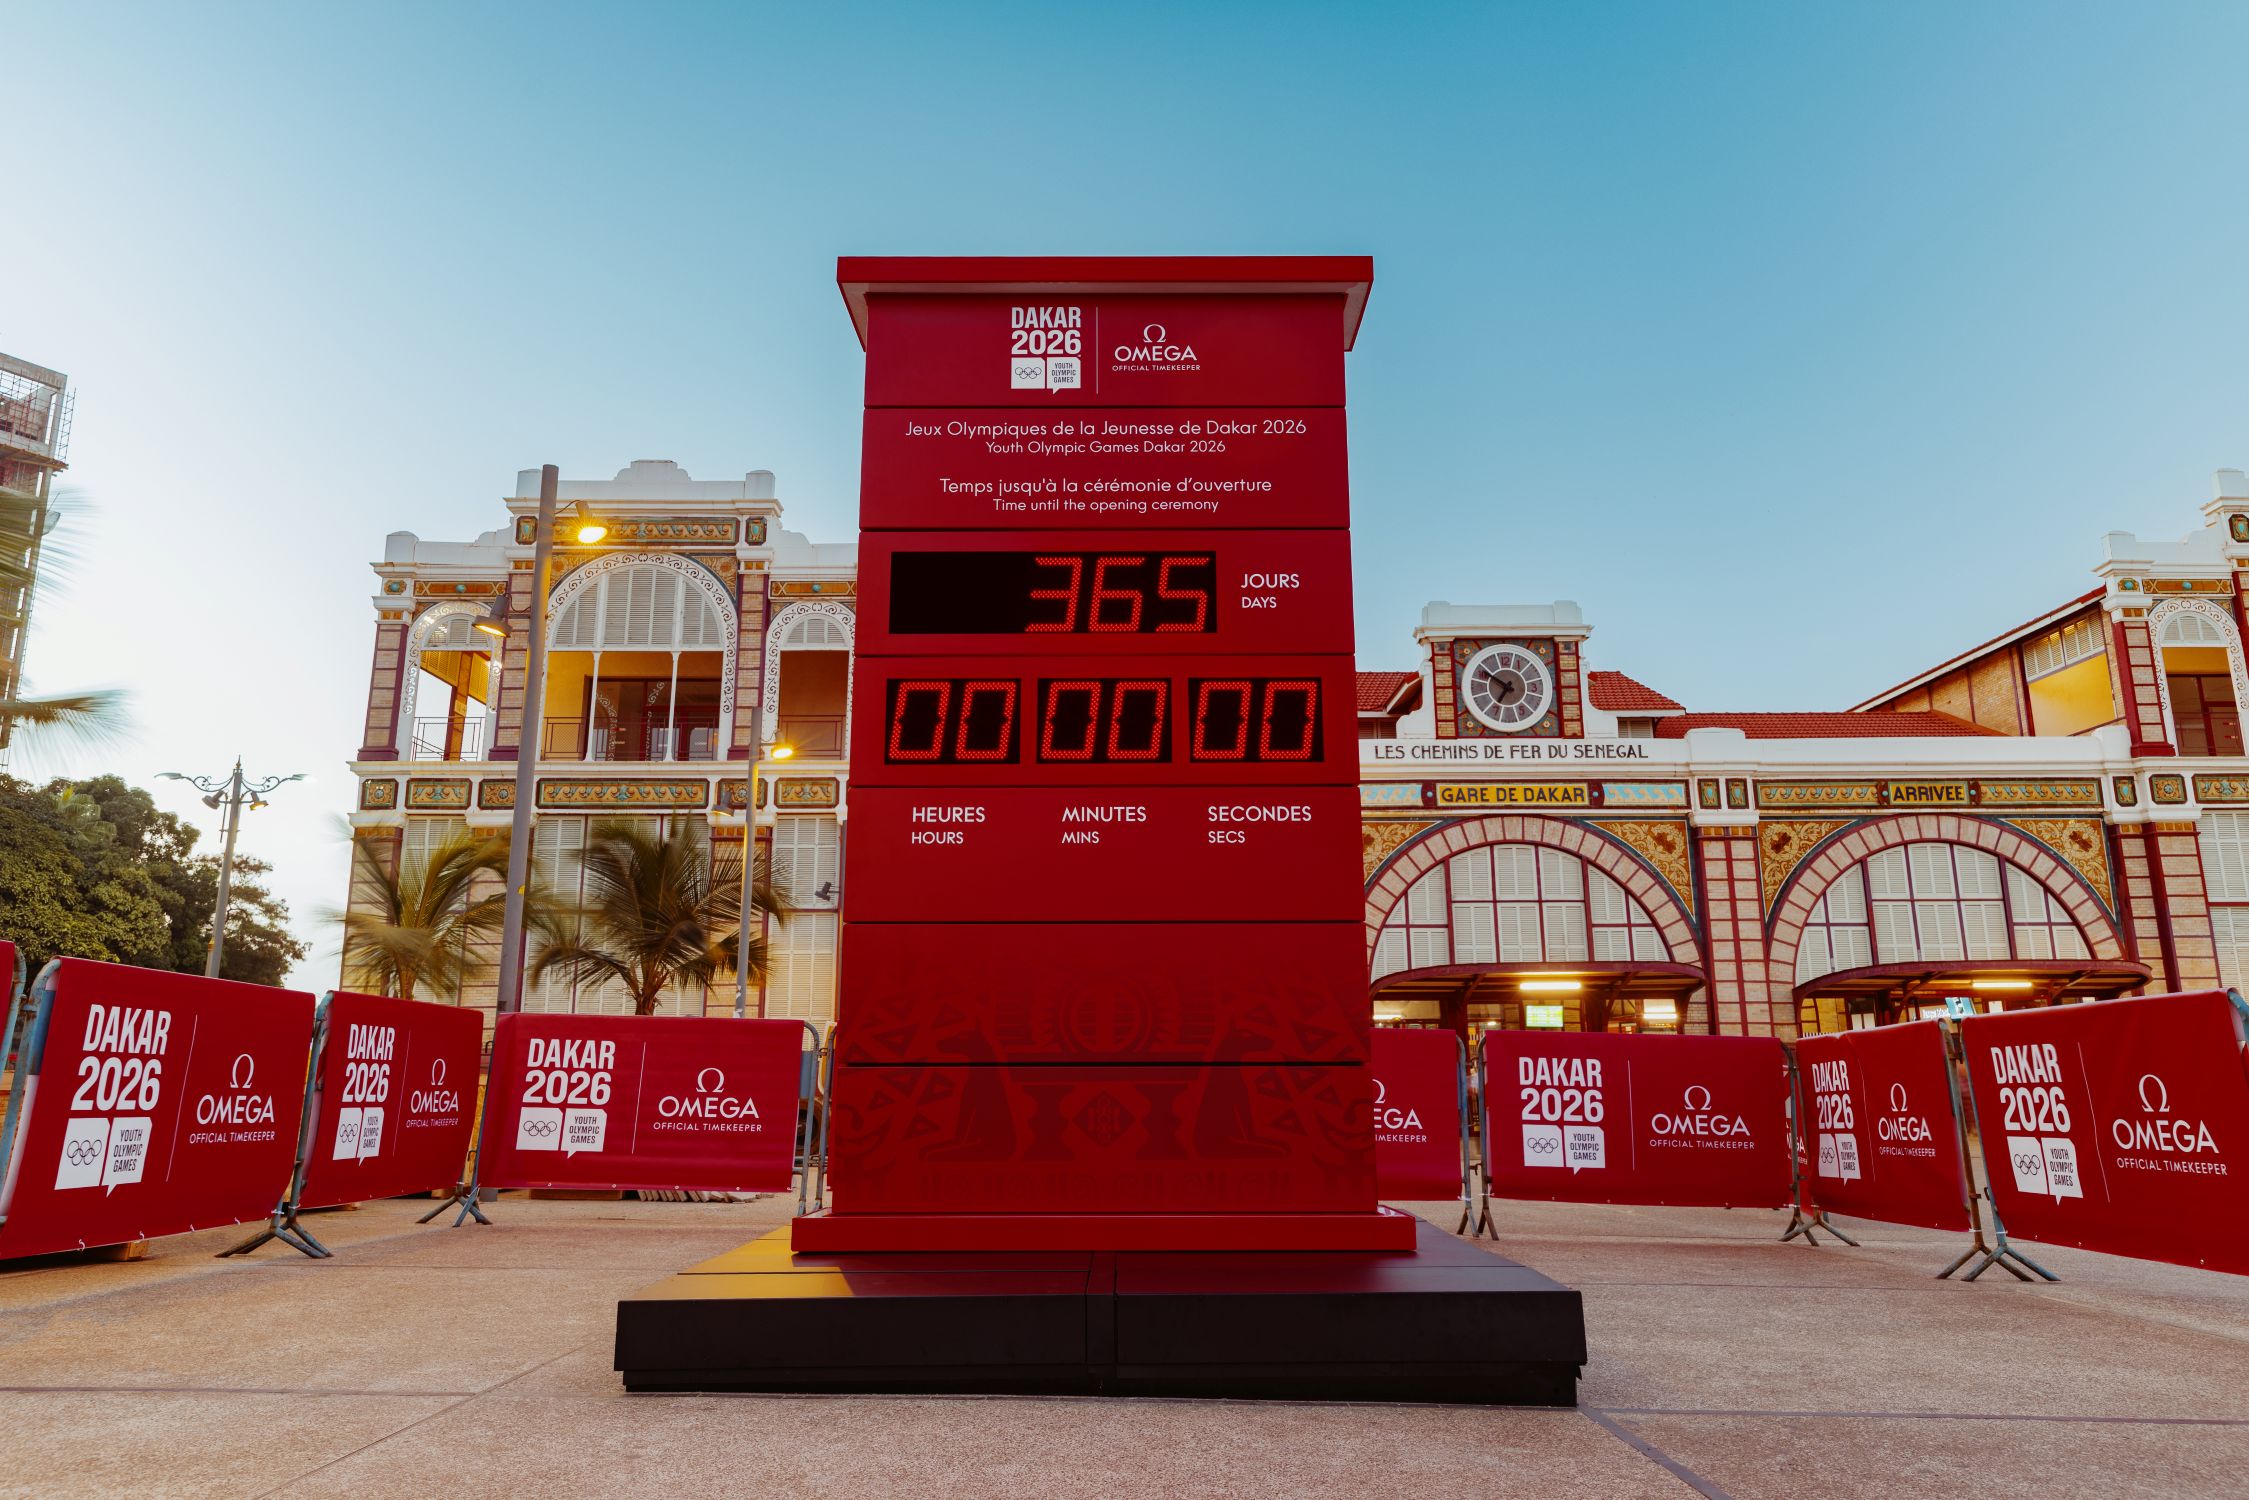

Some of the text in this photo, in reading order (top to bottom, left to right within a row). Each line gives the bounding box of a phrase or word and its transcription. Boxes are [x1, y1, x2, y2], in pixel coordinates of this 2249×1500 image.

[1011, 307, 1081, 328] DAKAR
[1011, 329, 1081, 355] 2026
[1114, 345, 1197, 362] OMEGA
[905, 419, 1306, 439] Jeux Olympiques de la Jeunesse de Dakar 2026
[986, 440, 1226, 456] Youth Olympic Games Dakar 2026
[940, 478, 993, 496] Temps
[1063, 478, 1078, 492] la
[1084, 478, 1171, 492] cérémonie
[993, 498, 1219, 514] Time until the opening ceremony
[1241, 573, 1299, 588] JOURS
[1025, 557, 1210, 632] 365
[1242, 596, 1277, 608] DAYS
[889, 681, 1017, 759] 00
[1040, 681, 1168, 759] 00
[1192, 681, 1318, 759] 00
[1375, 745, 1648, 759] LES CHEMINS DE FER DU SENEGAL
[1441, 787, 1584, 802] GARE DE DAKAR
[1893, 786, 1964, 801] ARRIVEE
[913, 807, 985, 822] HEURES
[1062, 806, 1146, 822] MINUTES
[1208, 806, 1311, 822] SECONDES
[912, 831, 963, 844] HOURS
[1062, 831, 1099, 844] MINS
[1208, 831, 1245, 843] SECS
[82, 1004, 171, 1055] DAKAR
[347, 1024, 395, 1060] DAKAR
[527, 1038, 616, 1069] DAKAR
[1990, 1043, 2062, 1084] DAKAR
[1519, 1057, 1602, 1087] DAKAR
[1812, 1060, 1850, 1093] DAKAR
[71, 1056, 161, 1111] 2026
[342, 1062, 390, 1103] 2026
[522, 1070, 611, 1105] 2026
[197, 1094, 274, 1125] OMEGA
[411, 1090, 458, 1113] OMEGA
[658, 1096, 759, 1118] OMEGA
[1521, 1087, 1604, 1123] 2026
[2000, 1086, 2071, 1133] 2026
[1817, 1093, 1854, 1129] 2026
[406, 1118, 458, 1128] OFFICIAL TIMEKEEPER
[574, 1116, 597, 1124] YOUTH
[653, 1122, 762, 1132] OFFICIAL TIMEKEEPER
[1651, 1113, 1750, 1136] OMEGA
[121, 1129, 142, 1142] YOUTH
[569, 1126, 599, 1134] OLYMPIC
[1573, 1133, 1595, 1141] YOUTH
[1878, 1117, 1932, 1141] OMEGA
[2113, 1119, 2219, 1153] OMEGA
[189, 1131, 275, 1144] OFFICIAL TIMEKEEPER
[571, 1135, 595, 1144] GAMES
[1375, 1135, 1427, 1143] IMEKEEPER
[1649, 1139, 1754, 1149] OFFICIAL TIMEKEEPER
[113, 1144, 143, 1157] OLYMPIC
[1570, 1142, 1599, 1151] OLYMPIC
[1879, 1146, 1936, 1157] OFFICIAL TIMEKEEPER
[2051, 1148, 2068, 1159] YOUTH
[1573, 1152, 1596, 1160] GAMES
[113, 1158, 137, 1172] GAMES
[2050, 1161, 2073, 1173] OLYMPIC
[2117, 1157, 2227, 1175] OFFICIAL TIMEKEEPER
[2054, 1174, 2073, 1186] GAMES
